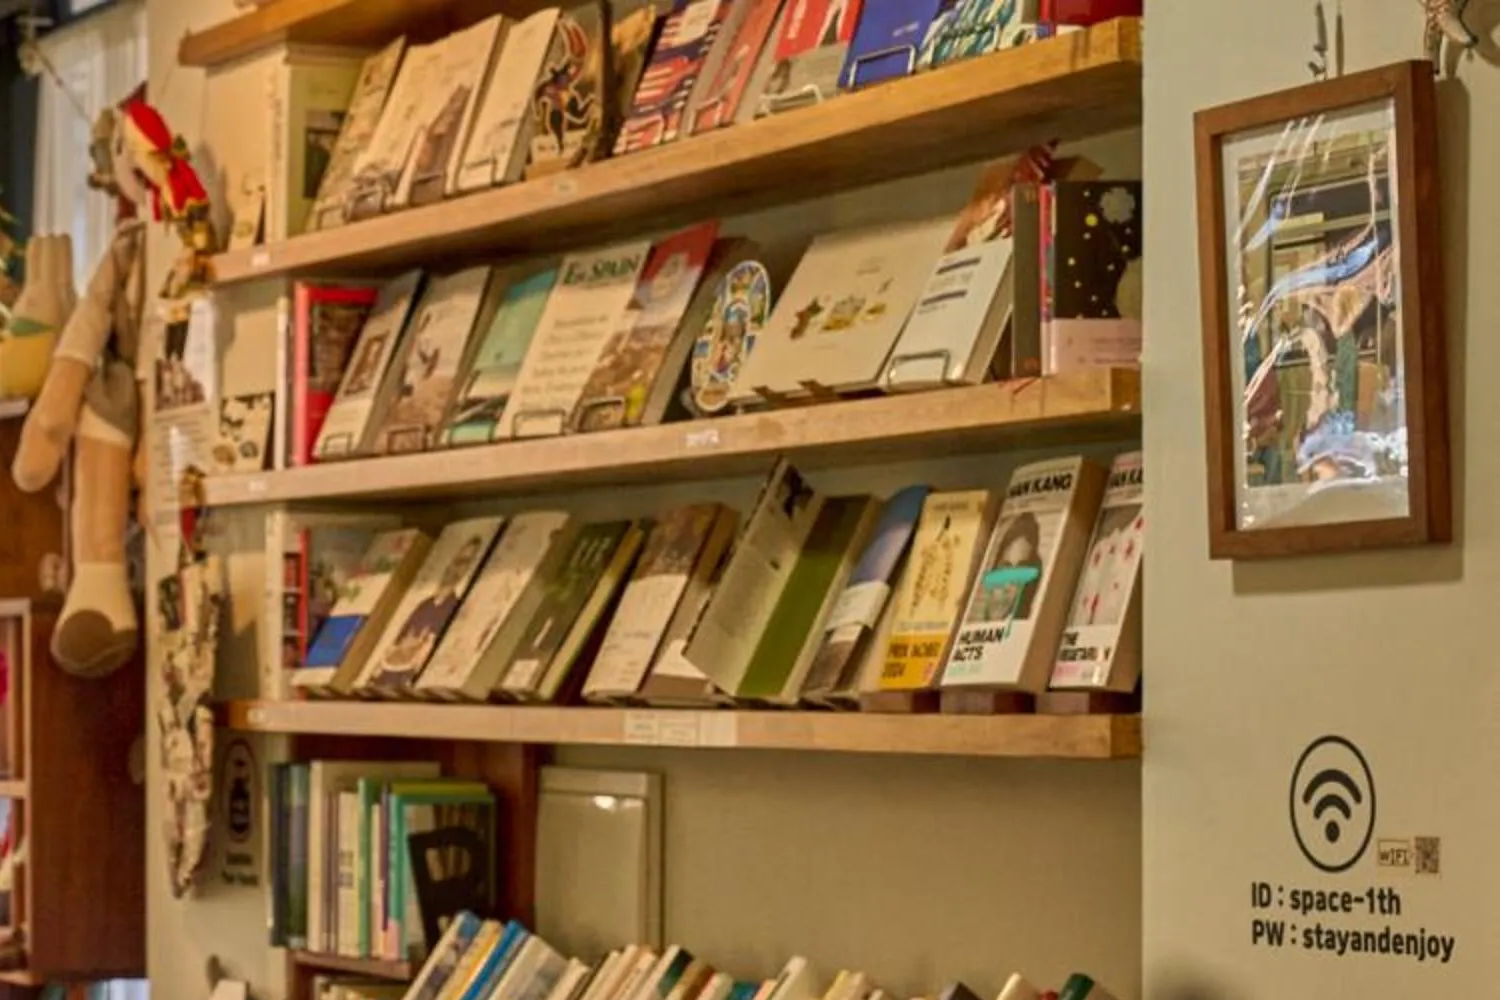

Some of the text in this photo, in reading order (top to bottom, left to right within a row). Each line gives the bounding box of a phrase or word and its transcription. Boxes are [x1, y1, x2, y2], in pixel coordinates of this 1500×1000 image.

[1032, 472, 1073, 493] KANG
[959, 627, 1004, 645] HUMAN
[953, 645, 984, 661] ACTS
[1290, 886, 1402, 916] space-1th
[1302, 922, 1455, 964] stayandenjoy
